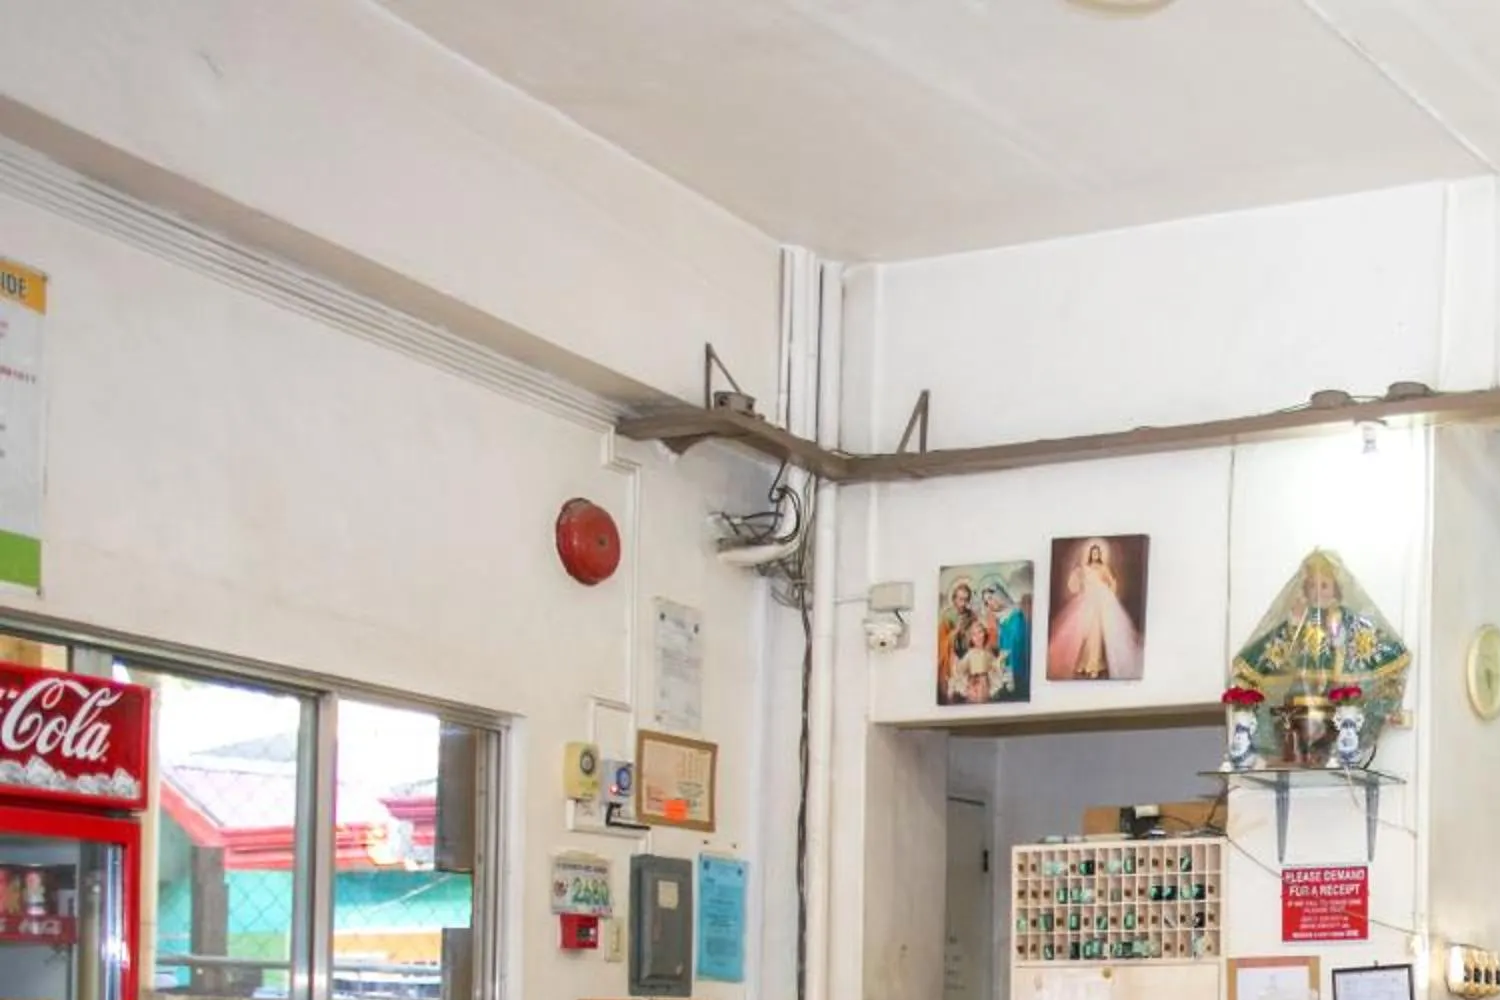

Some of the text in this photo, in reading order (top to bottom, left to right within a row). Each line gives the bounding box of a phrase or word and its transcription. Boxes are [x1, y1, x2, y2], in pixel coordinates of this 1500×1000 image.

[1285, 869, 1365, 883] PLEASE DEMAND
[1311, 885, 1319, 897] A
[1320, 883, 1361, 896] RECEIPT
